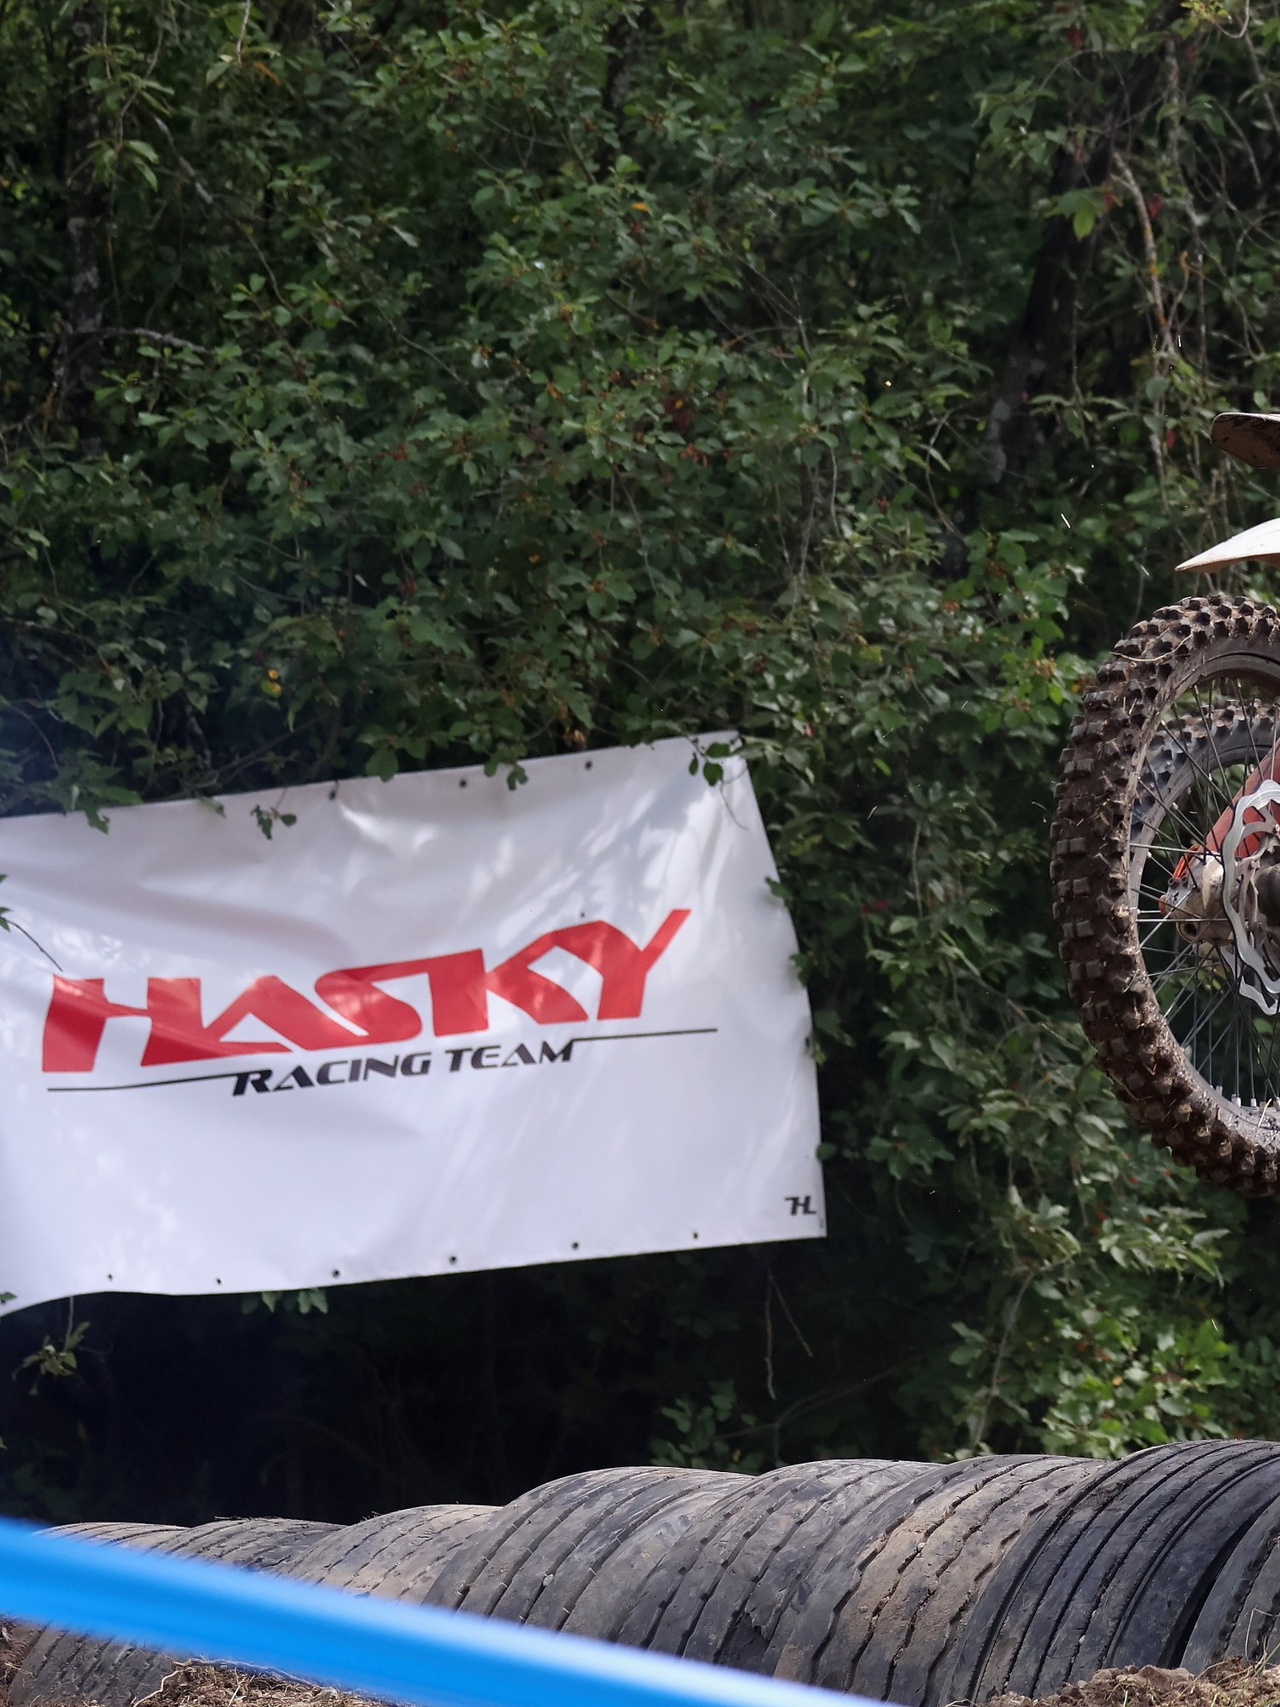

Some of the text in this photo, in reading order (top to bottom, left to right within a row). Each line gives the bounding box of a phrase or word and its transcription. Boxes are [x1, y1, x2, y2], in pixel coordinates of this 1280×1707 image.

[41, 908, 692, 1074] HASKY
[232, 1039, 576, 1097] RACING TEAM
